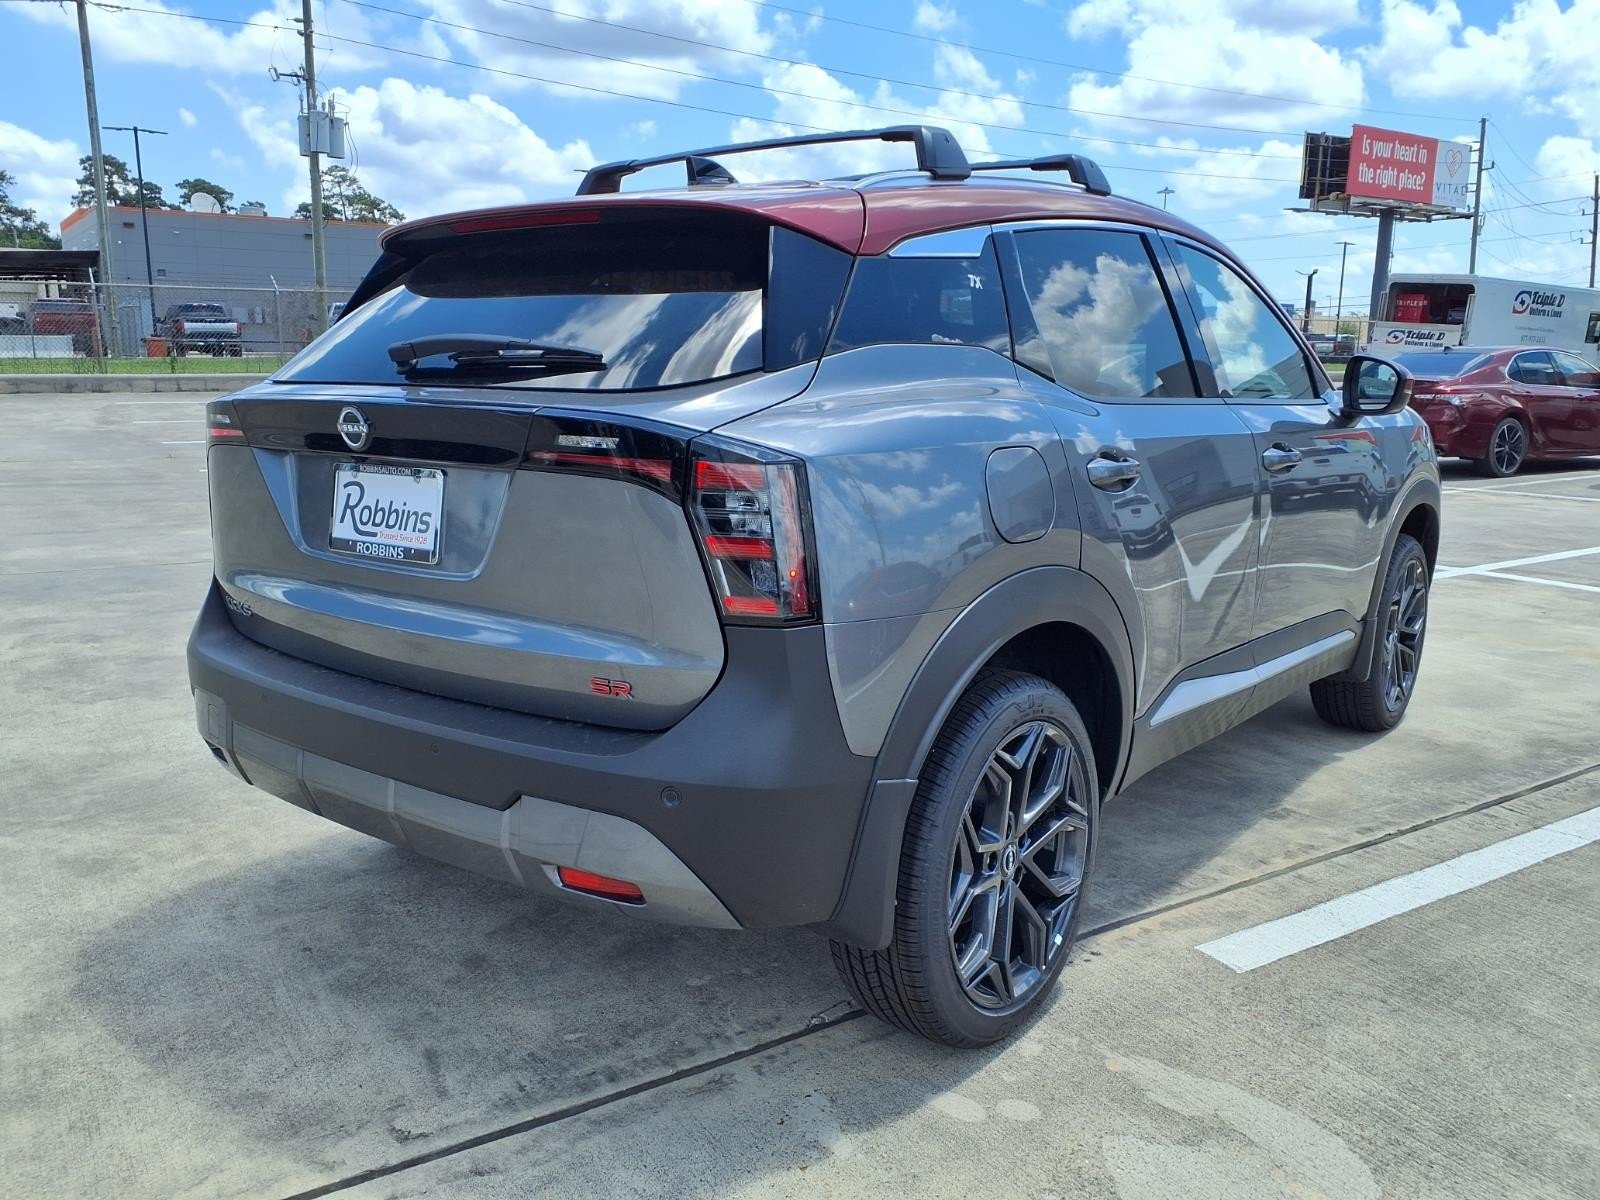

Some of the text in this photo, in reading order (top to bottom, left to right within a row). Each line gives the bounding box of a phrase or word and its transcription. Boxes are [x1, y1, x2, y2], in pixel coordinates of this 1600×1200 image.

[1362, 134, 1428, 164] Is your heart in
[1358, 162, 1426, 191] the right place?
[1531, 291, 1566, 308] Triple D
[1406, 330, 1446, 341] Triple D
[339, 481, 432, 537] Robbins
[356, 542, 405, 559] ROBBINS
[591, 677, 633, 700] SR
